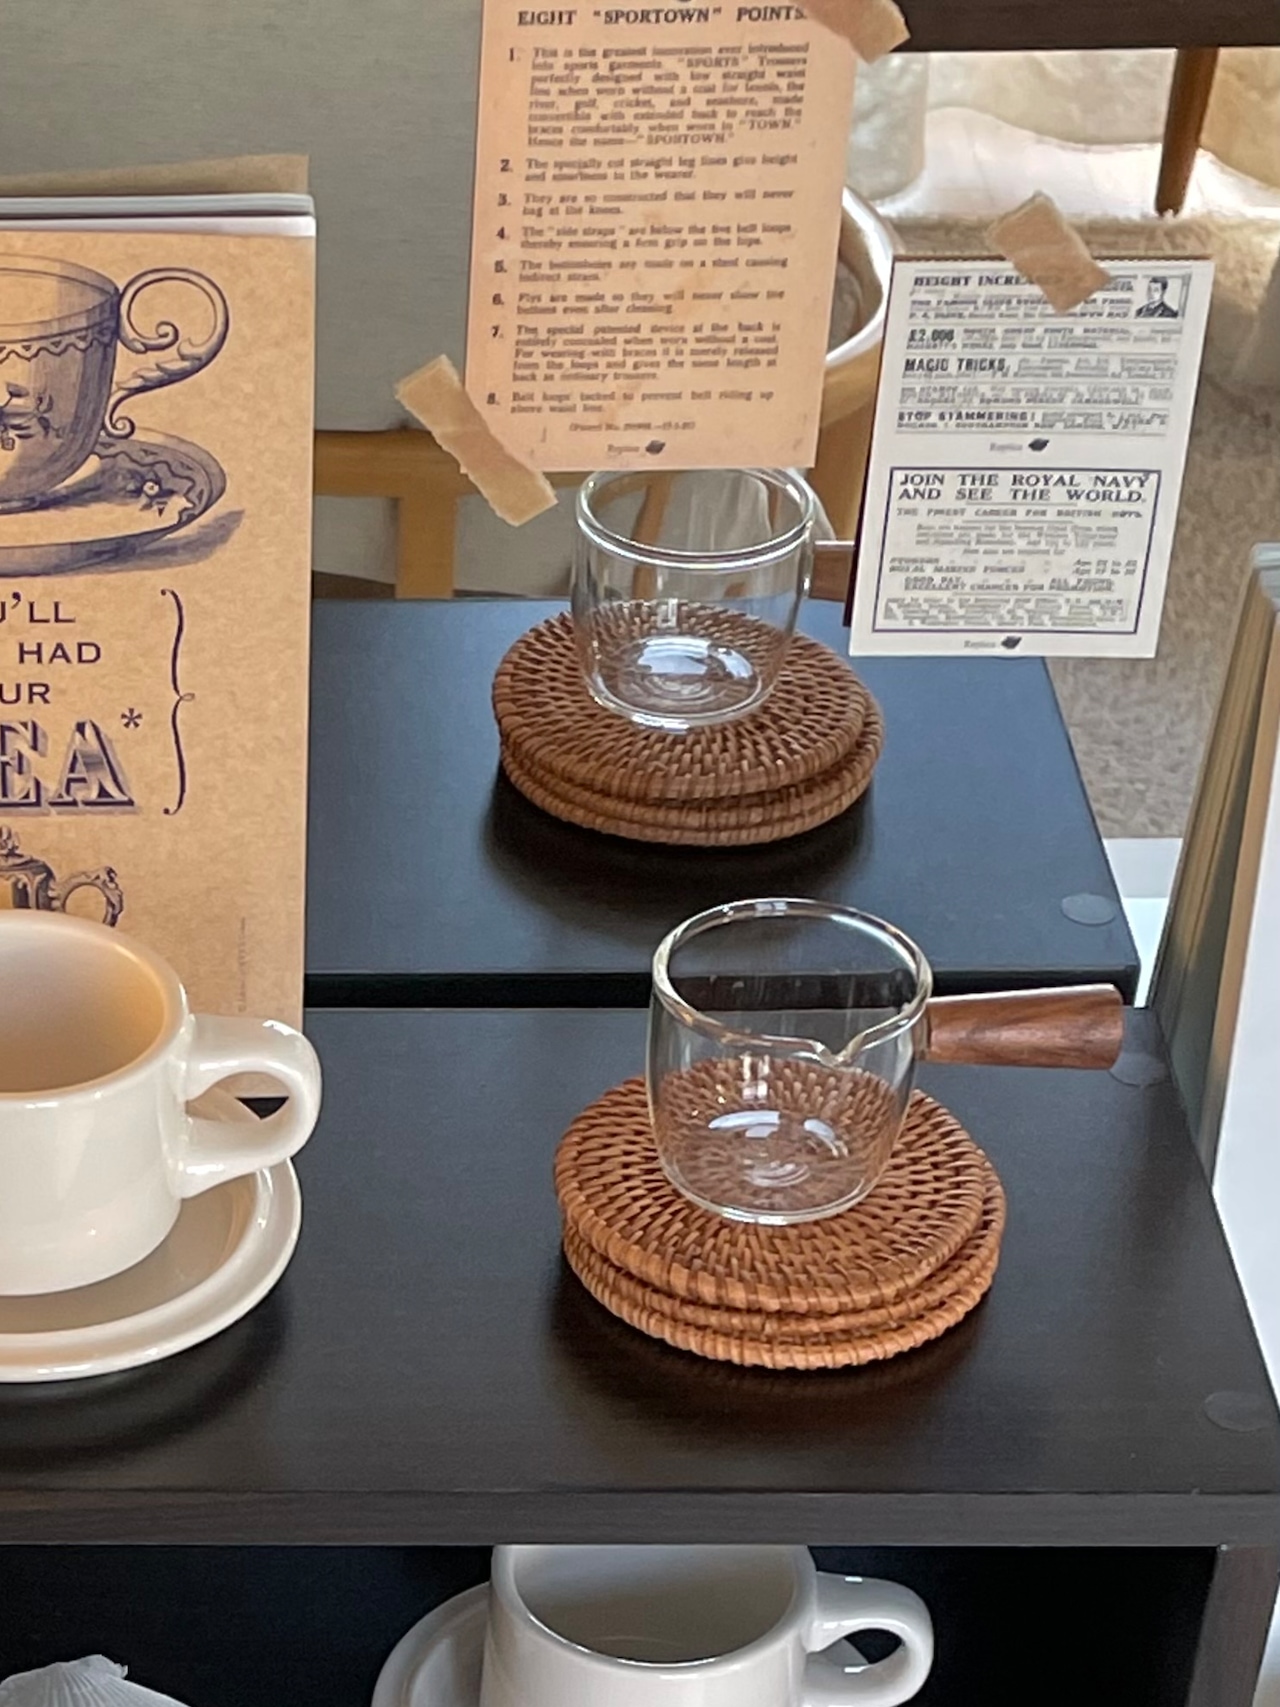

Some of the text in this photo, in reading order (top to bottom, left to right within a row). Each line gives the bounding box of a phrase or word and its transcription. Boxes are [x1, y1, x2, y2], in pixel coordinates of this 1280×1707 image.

[517, 10, 578, 26] EIGHT
[904, 358, 950, 372] MAGIC
[897, 411, 932, 422] STOP
[899, 473, 1151, 489] JOIN THE ROYAL NAVY
[898, 488, 942, 501] AND
[955, 488, 993, 501] SEE
[1010, 488, 1051, 502] THE
[18, 641, 102, 665] HAD
